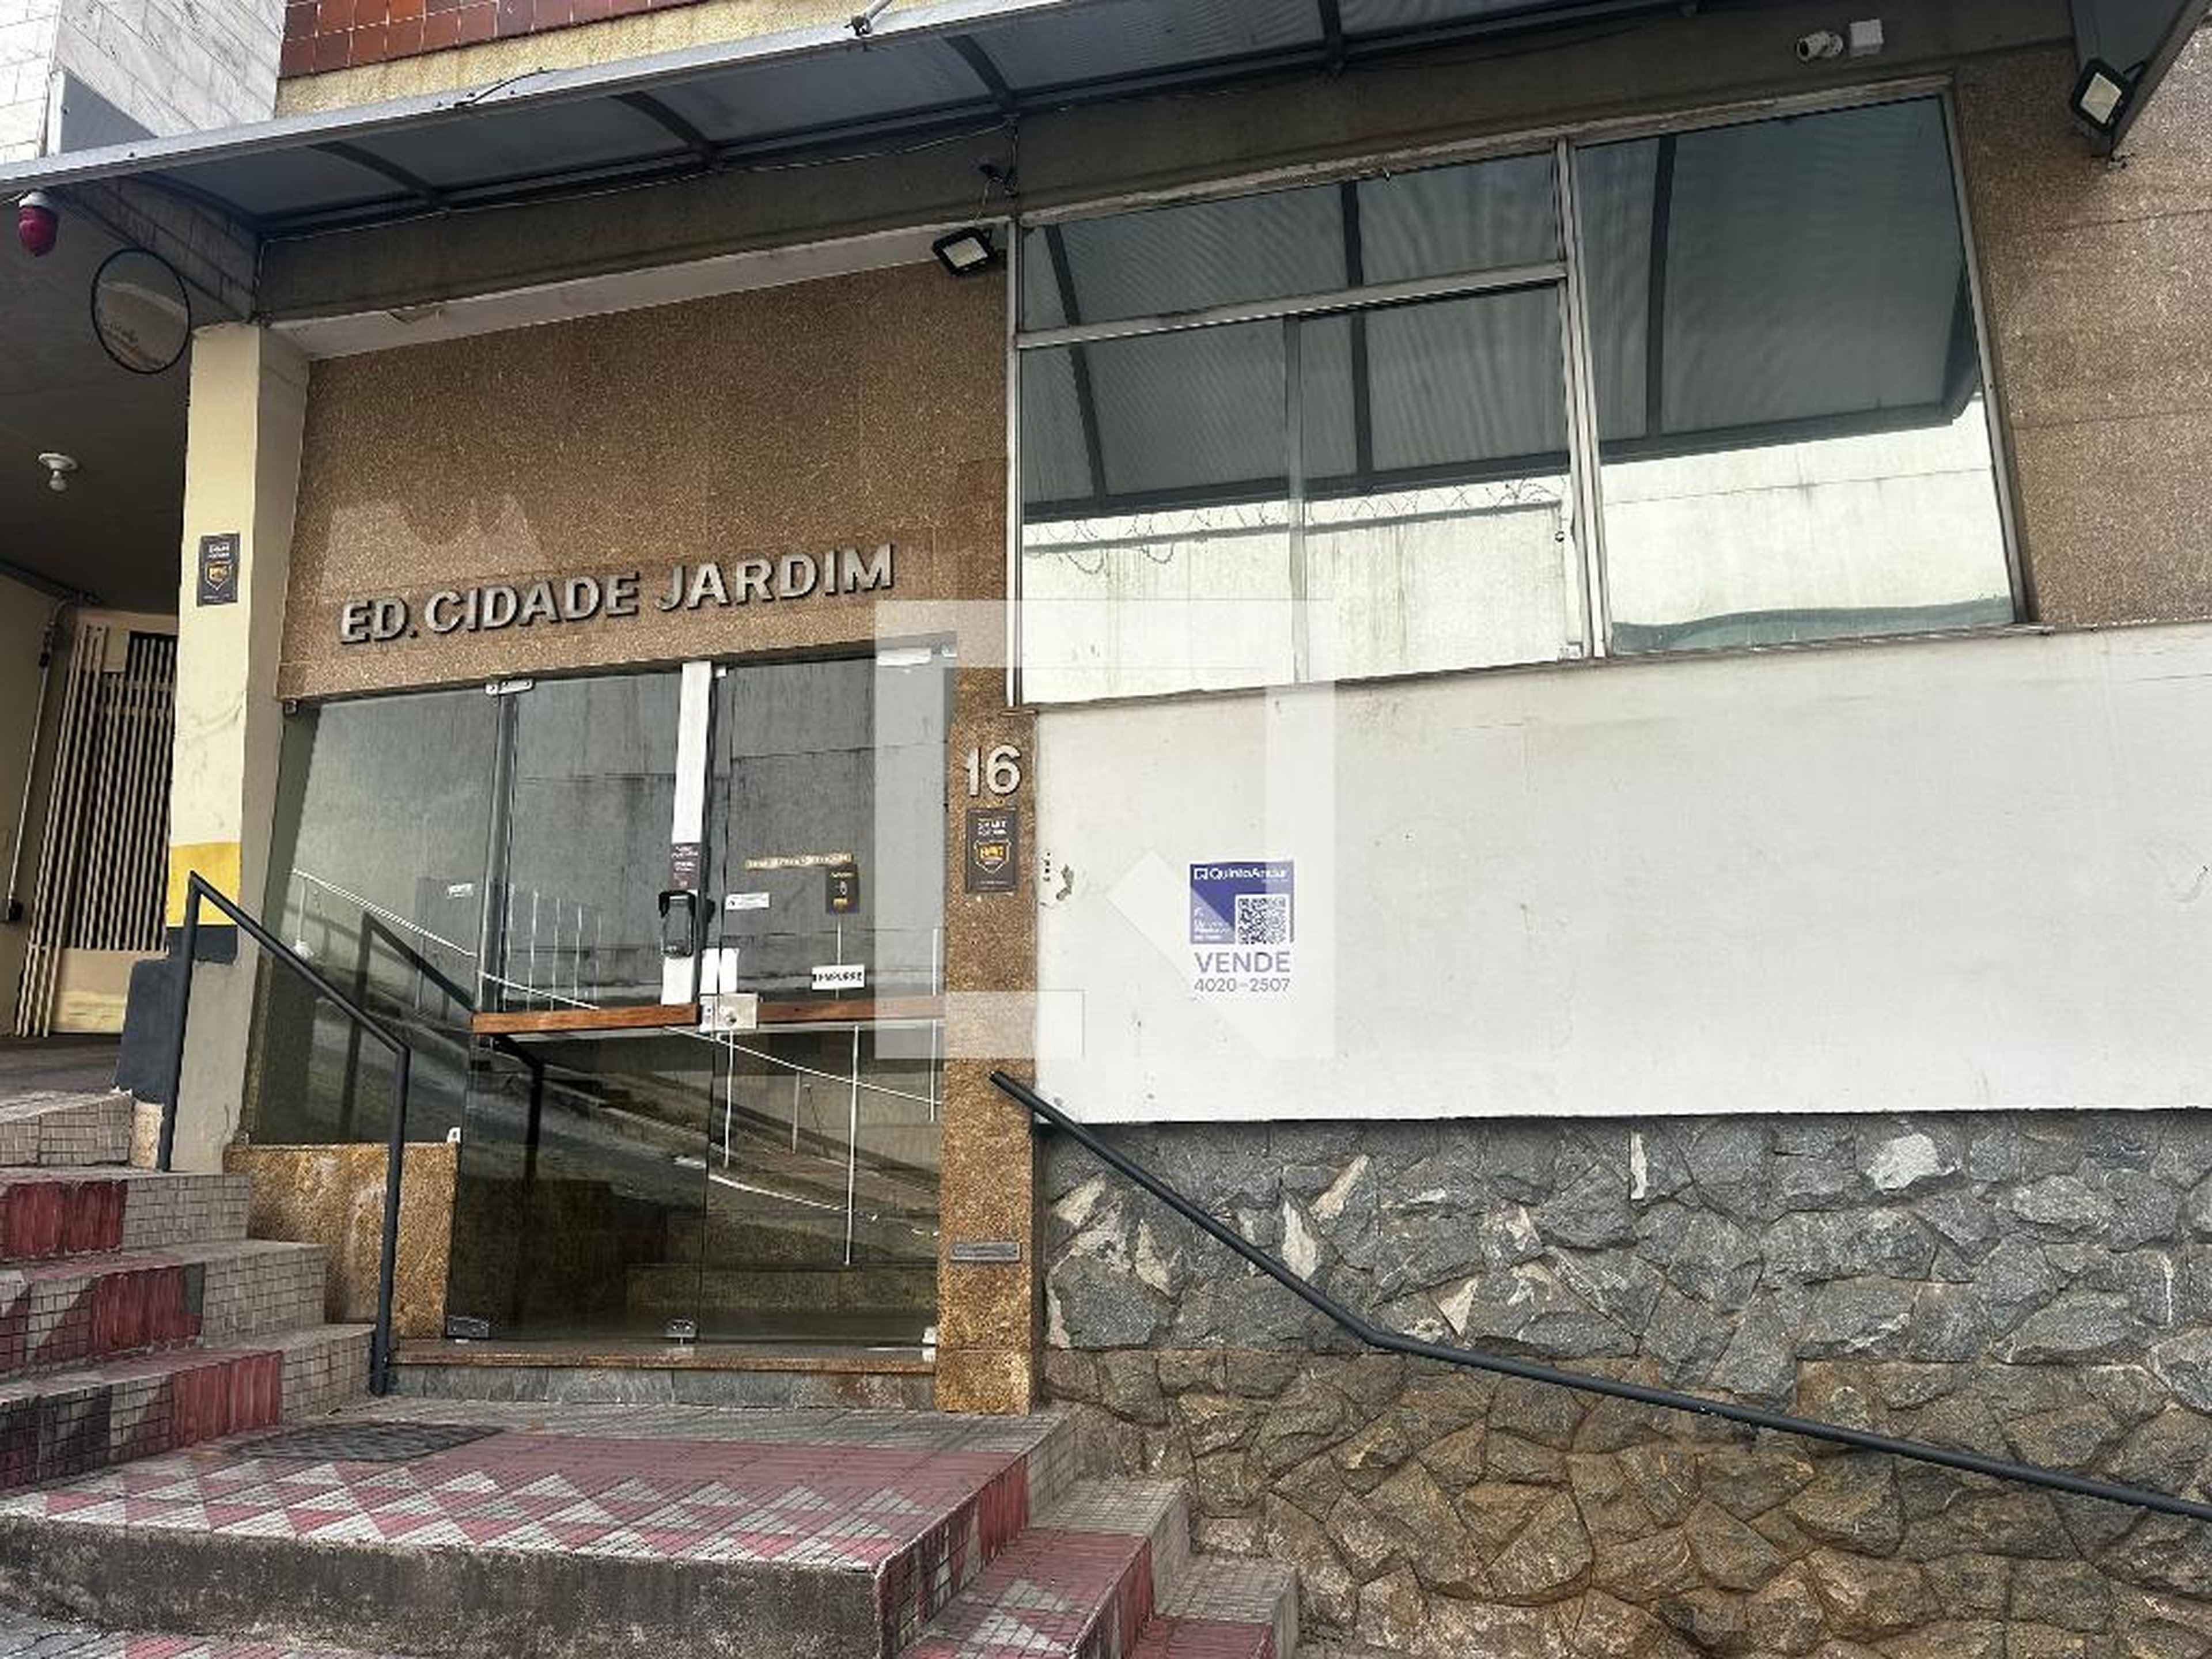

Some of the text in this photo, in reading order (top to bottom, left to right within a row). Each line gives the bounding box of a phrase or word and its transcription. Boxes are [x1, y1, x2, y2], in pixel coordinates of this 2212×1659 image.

[340, 543, 896, 643] ED. CIDADE JARDIM
[967, 743, 1022, 797] 16
[1194, 951, 1291, 973] VENDE
[1194, 978, 1291, 992] 4020-2507
